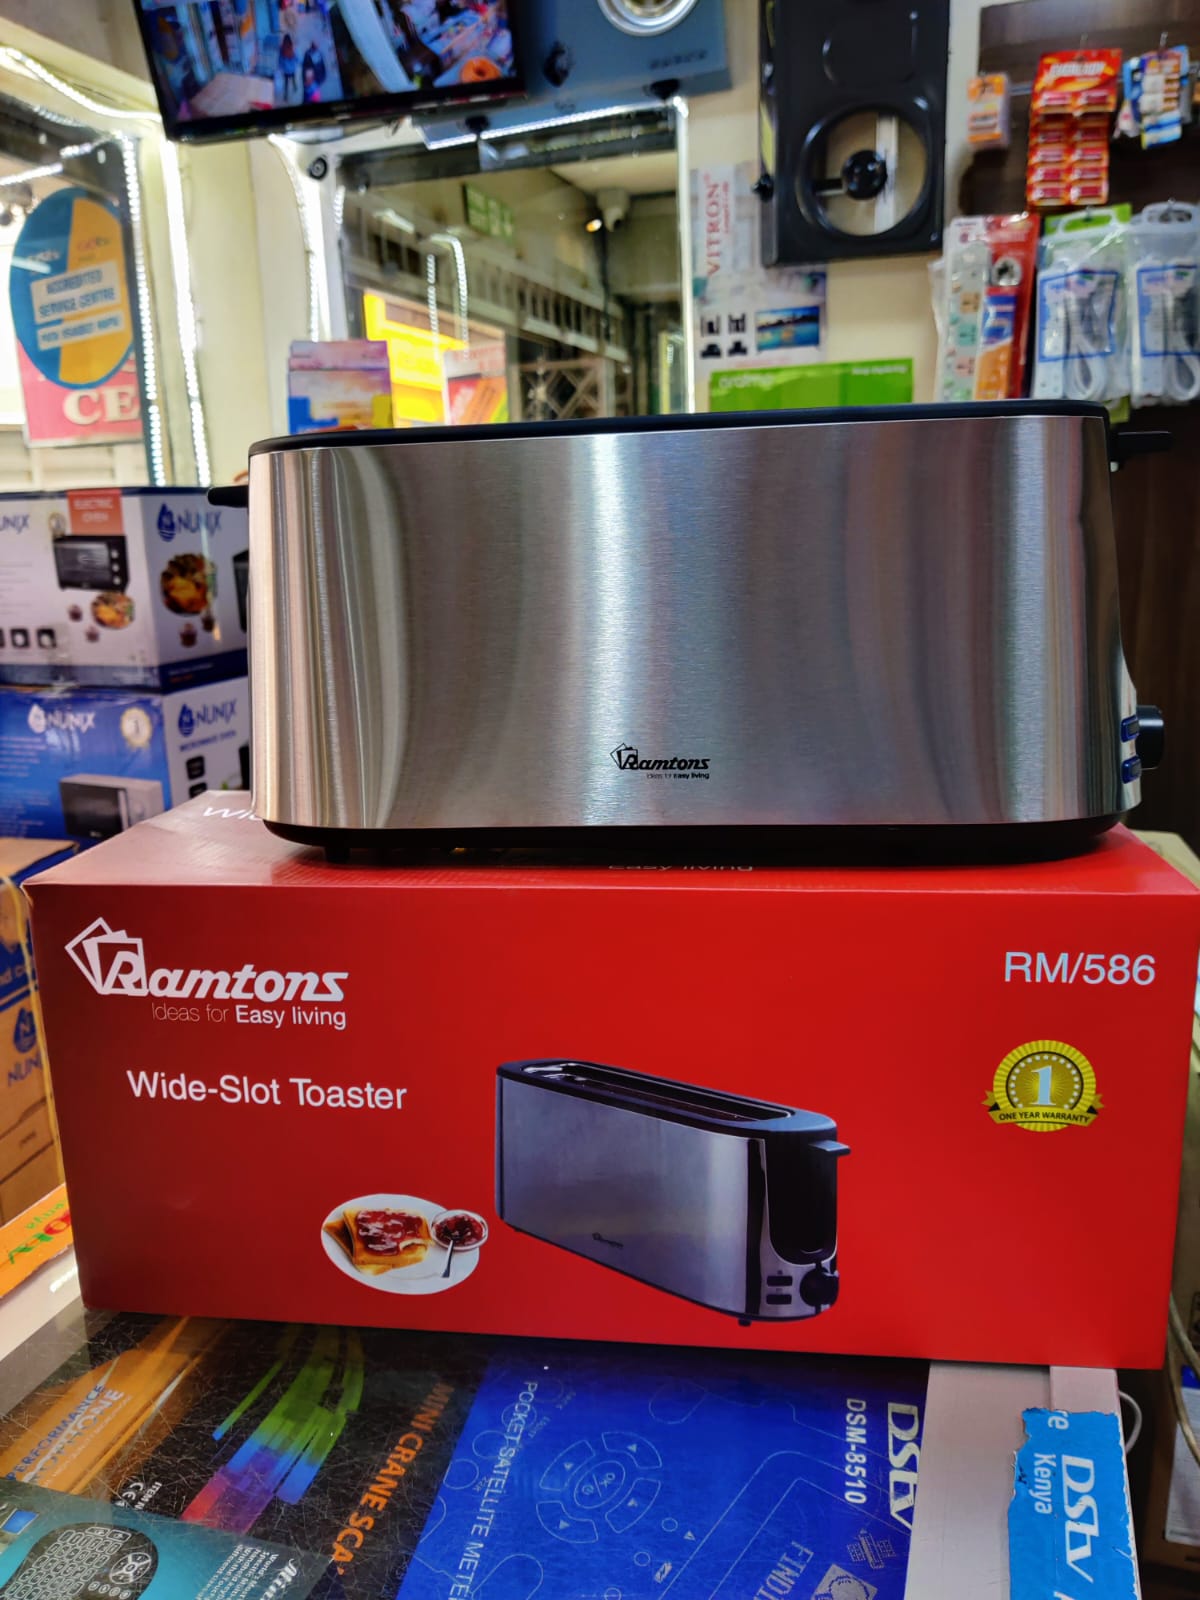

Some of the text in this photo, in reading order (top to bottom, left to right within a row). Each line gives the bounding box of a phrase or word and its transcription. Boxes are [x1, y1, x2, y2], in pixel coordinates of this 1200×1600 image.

[705, 183, 721, 277] VITRON
[620, 750, 711, 770] Ramtons
[691, 772, 710, 780] living
[98, 943, 348, 1002] Ramtons
[1004, 951, 1156, 985] RM/586
[151, 1002, 347, 1031] Ideas for Easy living
[126, 1069, 408, 1112] Wide-Slot Toaster
[1029, 1064, 1057, 1106] 1
[998, 1111, 1090, 1123] ONE YEAR WARRANTY
[410, 1382, 455, 1432] MINI
[503, 1380, 538, 1445] POCKET
[362, 1432, 425, 1512] CRANE
[844, 1396, 867, 1505] DSM-8510
[470, 1445, 516, 1538] SATELLITE
[1028, 1452, 1056, 1515] Kenya
